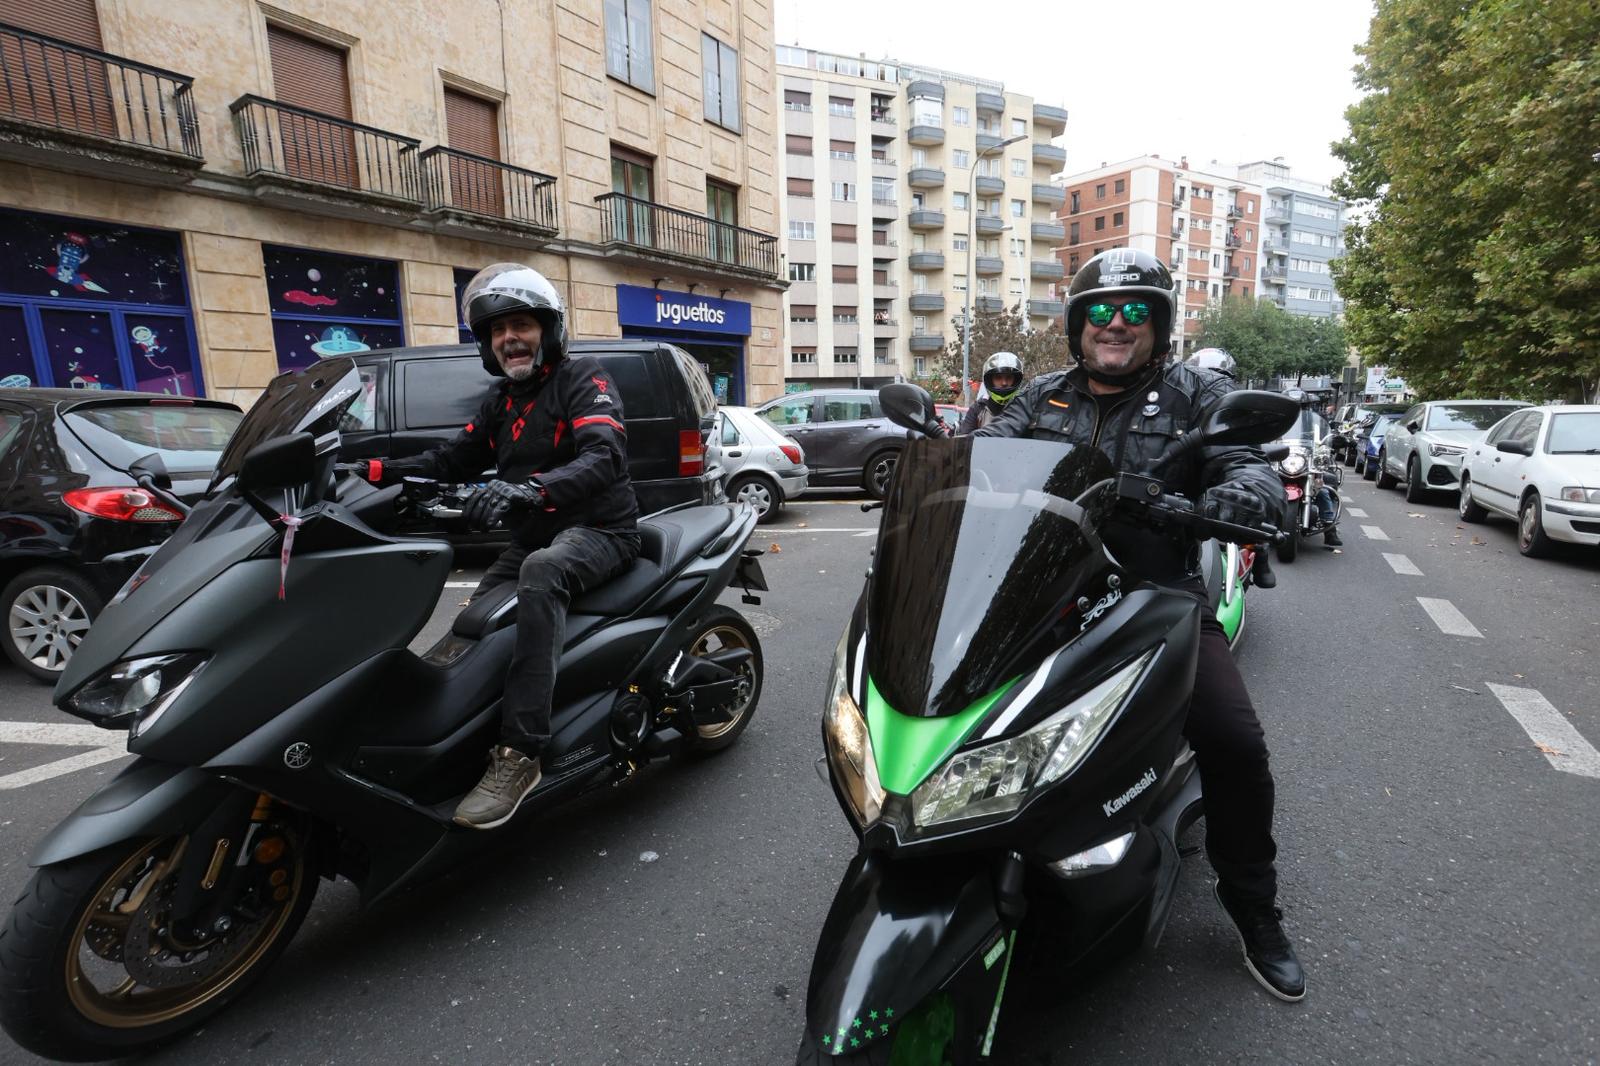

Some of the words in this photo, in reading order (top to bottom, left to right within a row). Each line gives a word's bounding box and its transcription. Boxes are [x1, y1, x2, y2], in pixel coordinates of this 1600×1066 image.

[1098, 273, 1140, 283] SHIRO
[656, 295, 724, 324] juguettos
[1102, 767, 1157, 817] Kawasaki
